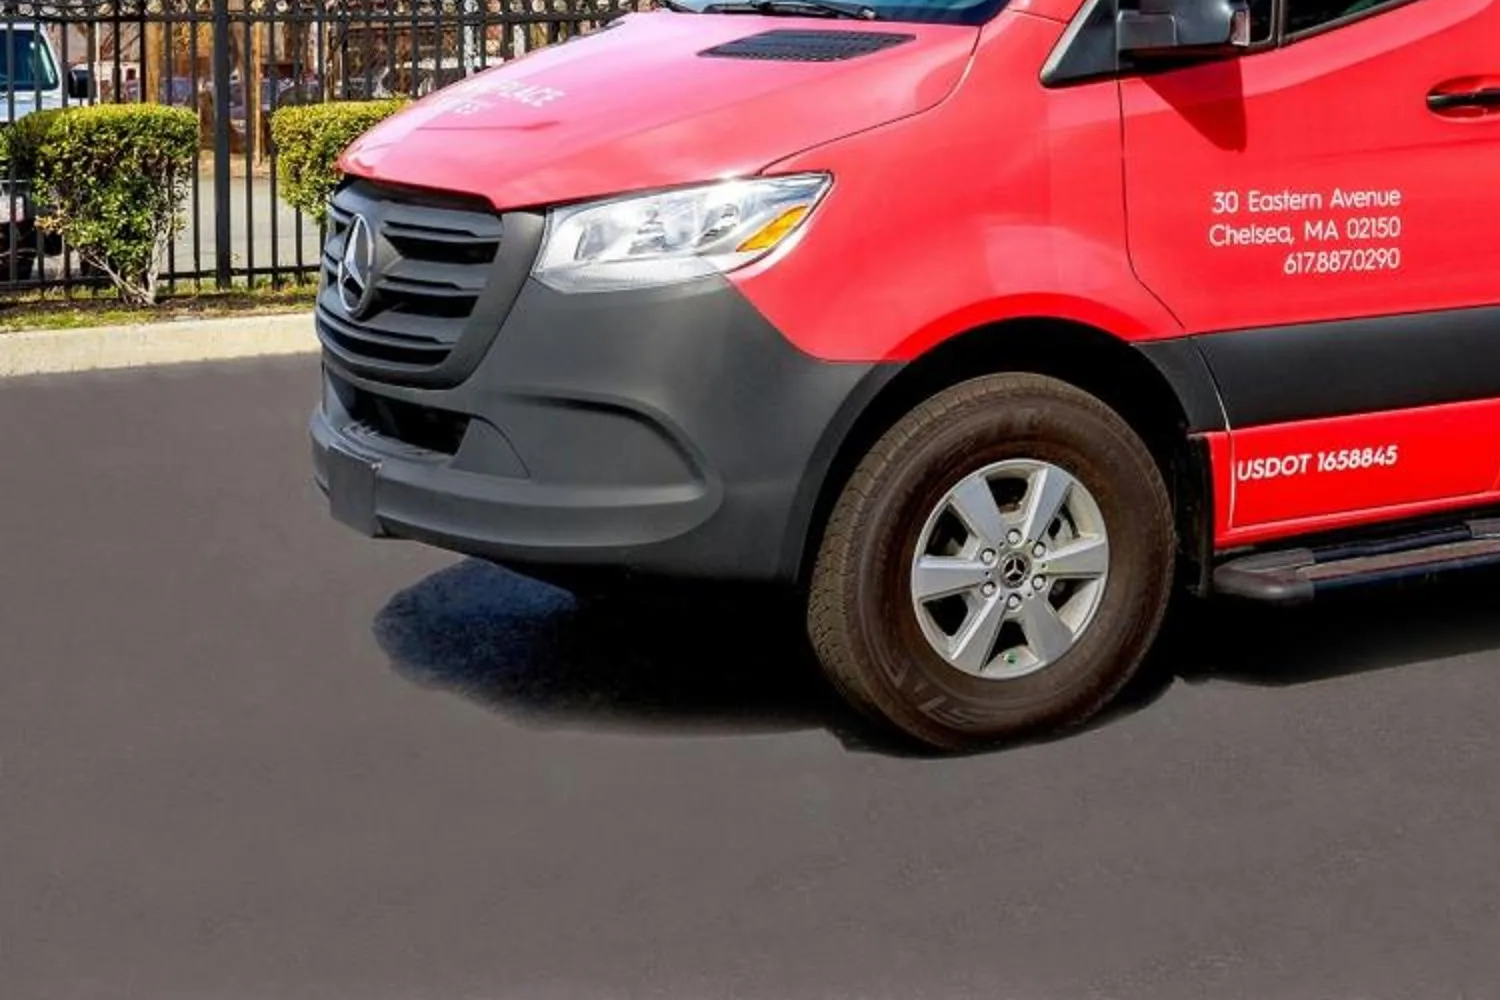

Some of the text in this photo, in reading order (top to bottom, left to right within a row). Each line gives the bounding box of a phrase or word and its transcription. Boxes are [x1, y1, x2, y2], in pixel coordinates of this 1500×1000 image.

[1212, 188, 1401, 214] 30 Eastern Avenue
[1209, 216, 1401, 246] Chelsea, MA 02150
[1284, 247, 1400, 274] 617.887.0290
[1237, 445, 1397, 480] USDOT 1658845
